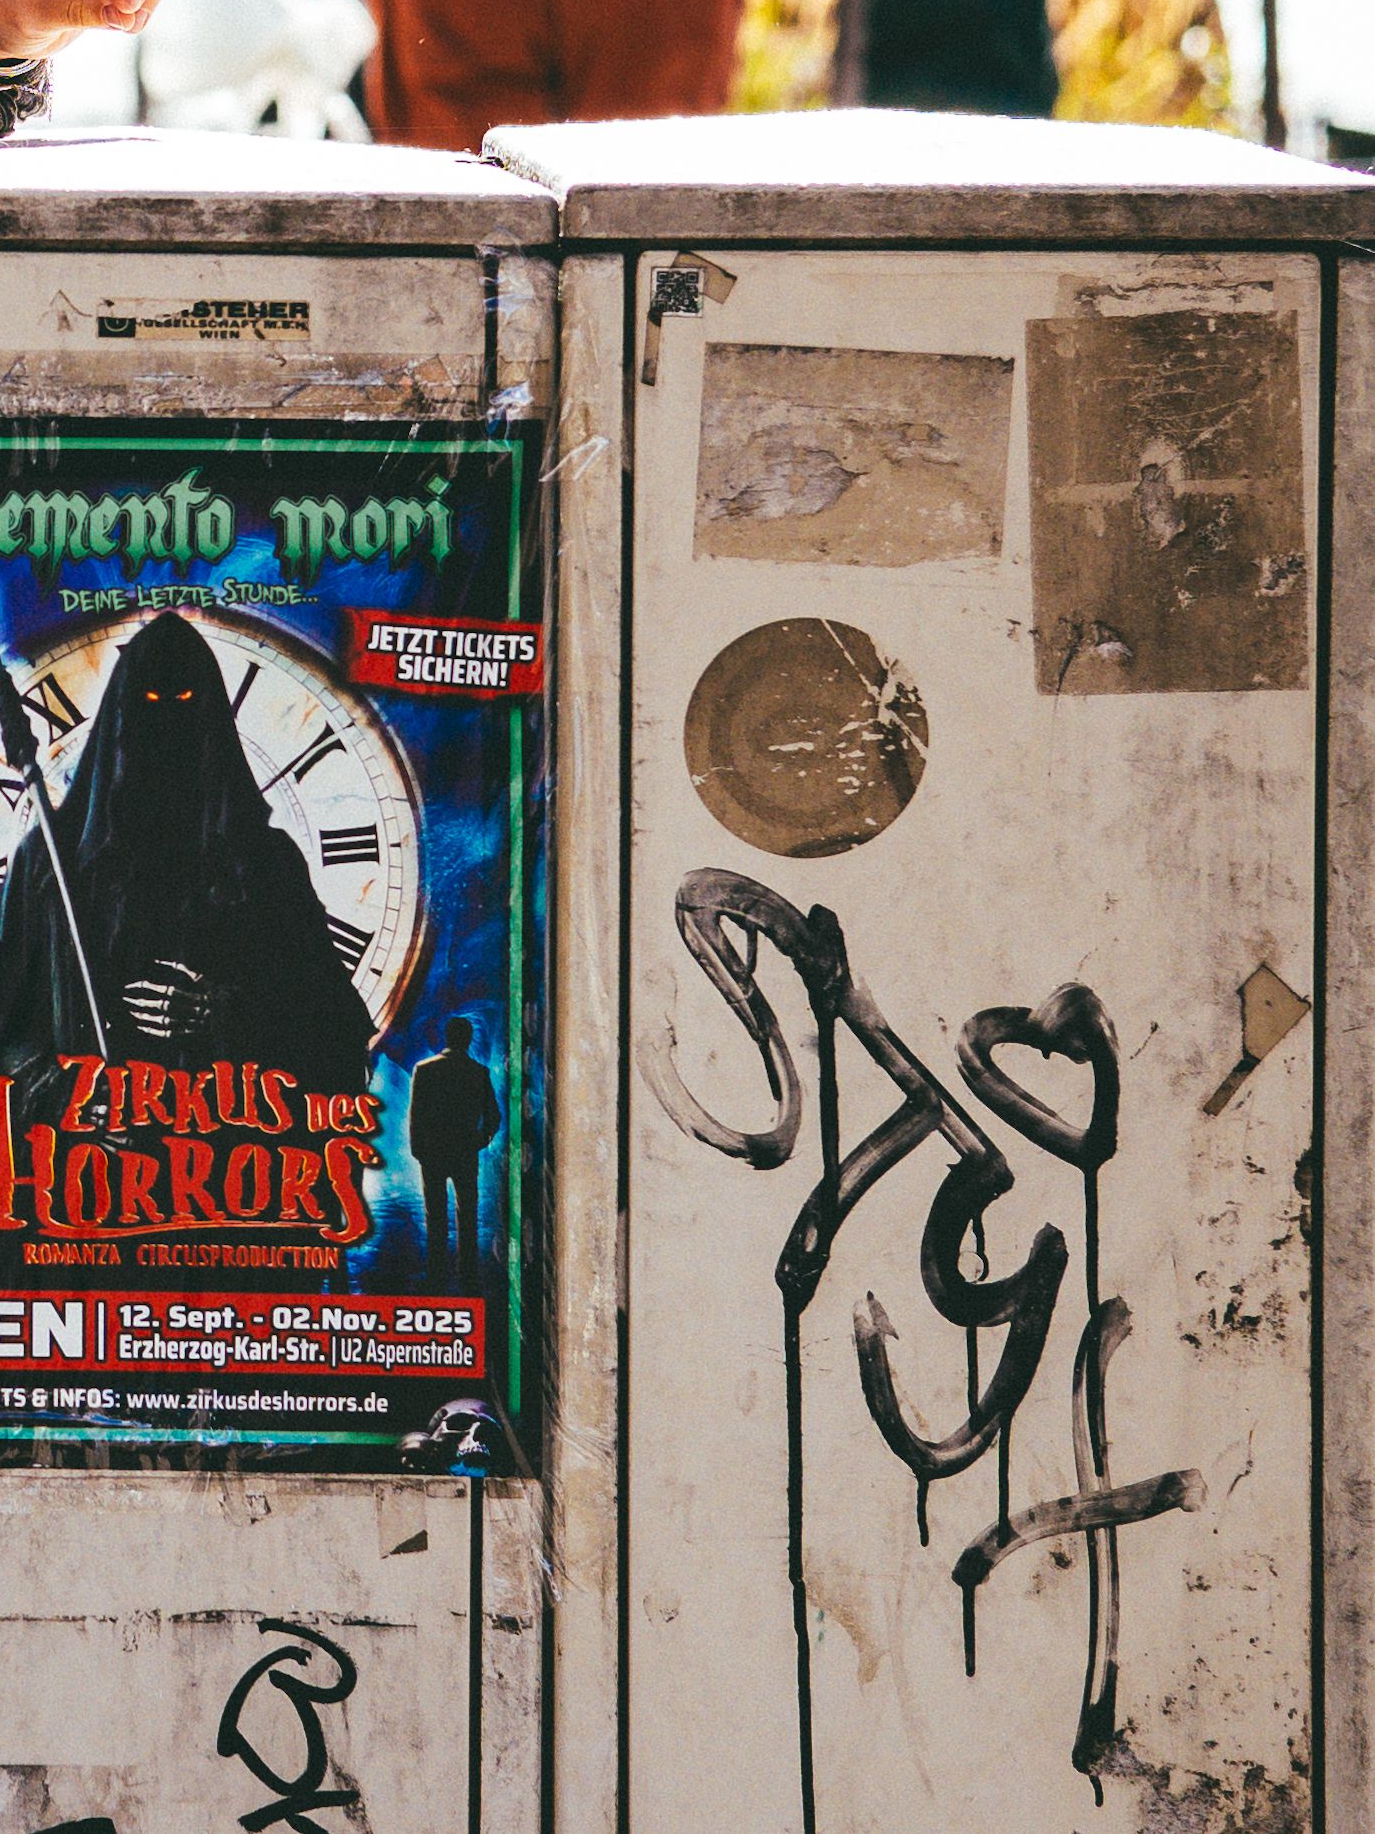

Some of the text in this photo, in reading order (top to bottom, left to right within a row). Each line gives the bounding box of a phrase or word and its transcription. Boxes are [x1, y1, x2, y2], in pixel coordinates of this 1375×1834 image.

[199, 330, 240, 339] WIEN
[270, 473, 453, 581] mori
[367, 625, 535, 662] JETZT TICKETS
[398, 656, 508, 687] SICHERN!
[58, 1054, 297, 1135] ZIRKUS
[22, 1243, 339, 1270] ROMANZA CIRCUSPRODUCTION
[119, 1304, 160, 1329] 12.
[169, 1305, 244, 1333] Sept.
[395, 1309, 472, 1334] 2025
[119, 1335, 473, 1369] Erzherzog-Karl-Str. U2 Aspernstraße
[32, 1388, 48, 1408] &
[53, 1388, 121, 1409] INFOS:
[126, 1389, 389, 1413] www.zirkusdeshorrors.de
